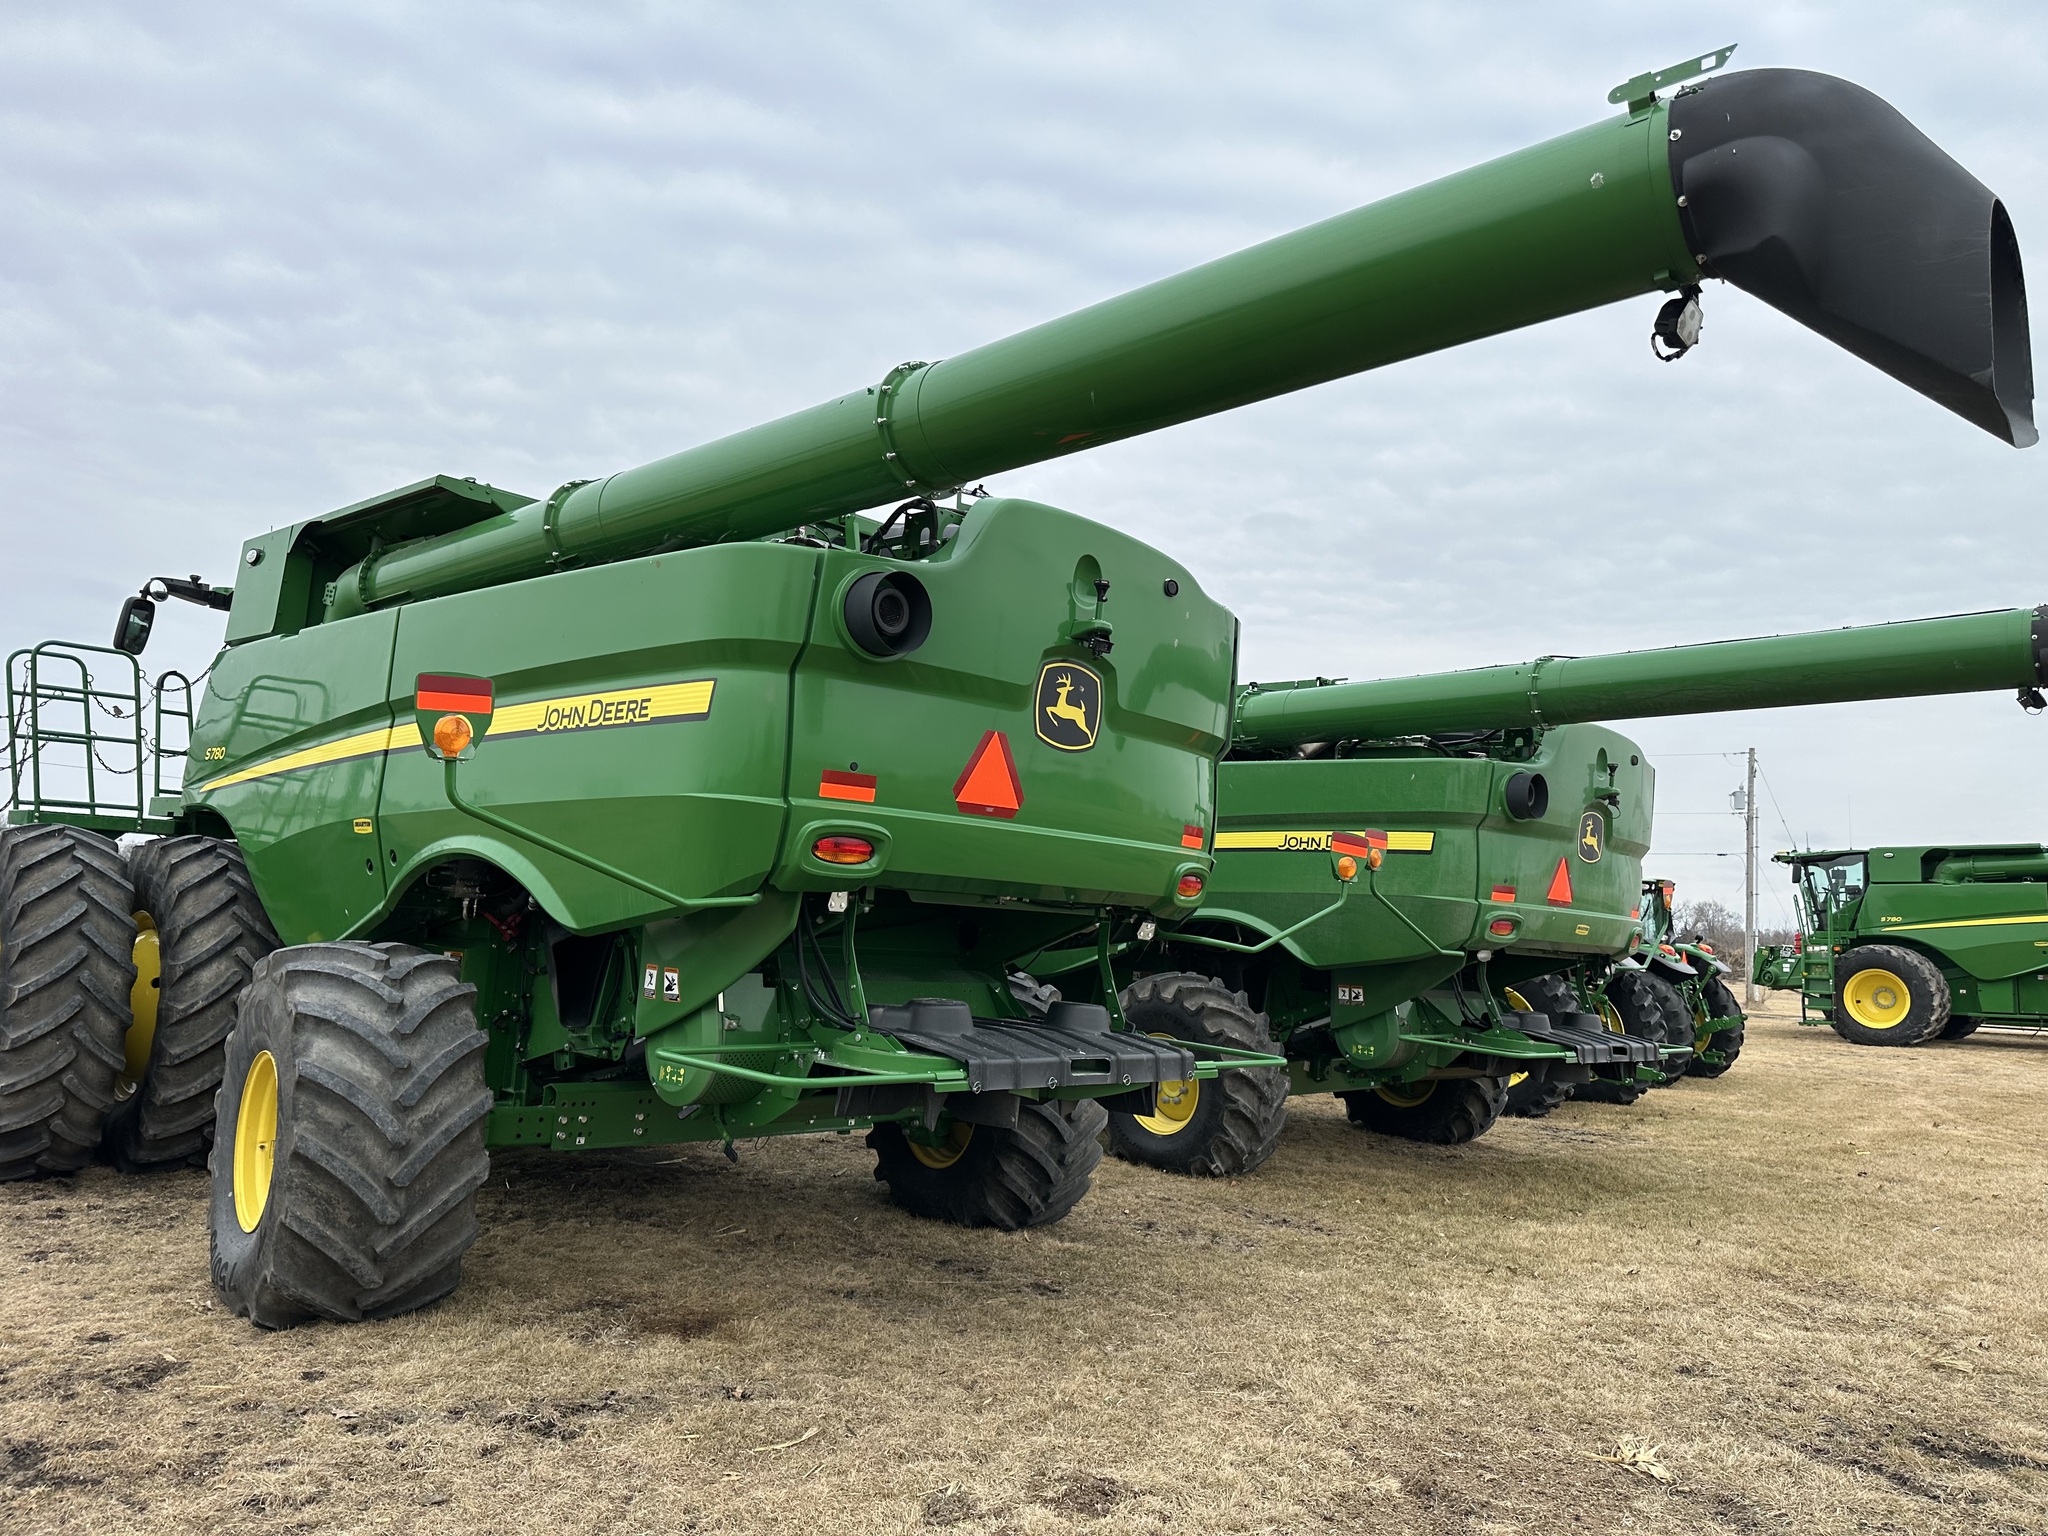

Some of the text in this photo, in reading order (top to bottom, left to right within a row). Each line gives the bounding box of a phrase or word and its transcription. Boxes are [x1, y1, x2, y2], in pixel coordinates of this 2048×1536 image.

[537, 697, 652, 729] JOHN DEERE
[204, 746, 226, 761] S780
[1277, 834, 1322, 849] JOHN
